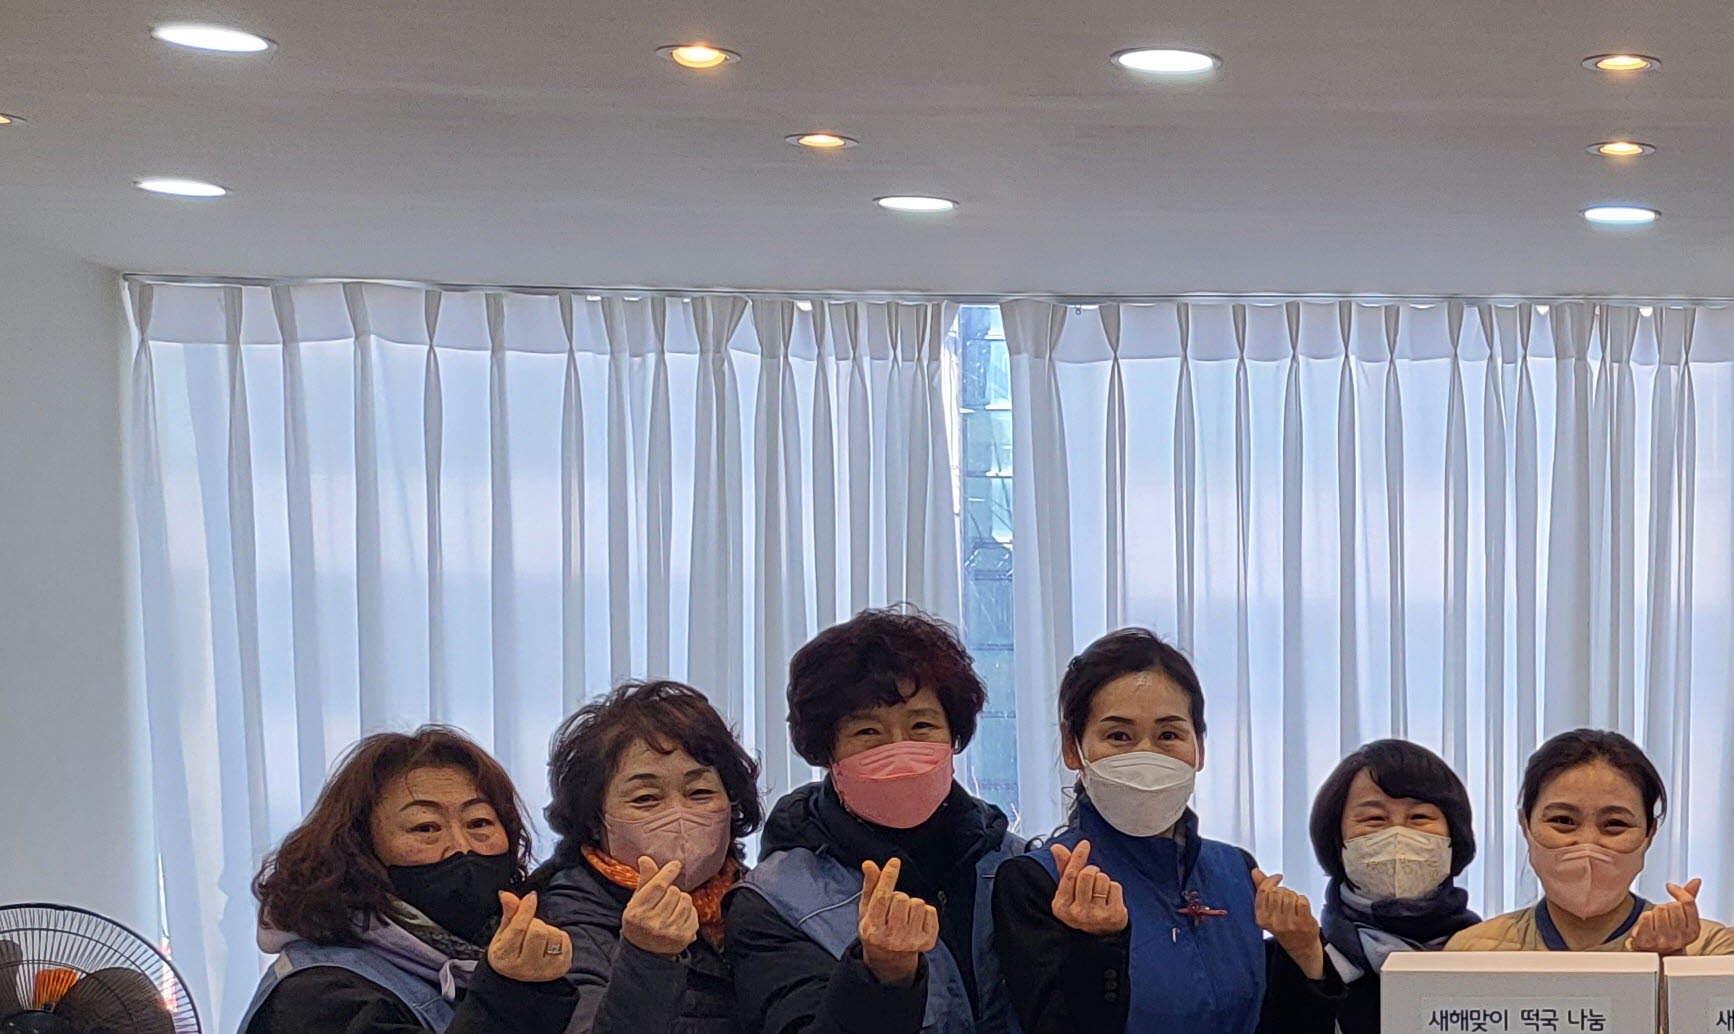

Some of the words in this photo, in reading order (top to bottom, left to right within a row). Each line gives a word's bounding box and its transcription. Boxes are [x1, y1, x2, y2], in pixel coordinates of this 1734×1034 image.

[1428, 1009, 1508, 1033] 새해맞이
[1520, 1009, 1560, 1032] 떡국
[1568, 1008, 1607, 1032] 나눔
